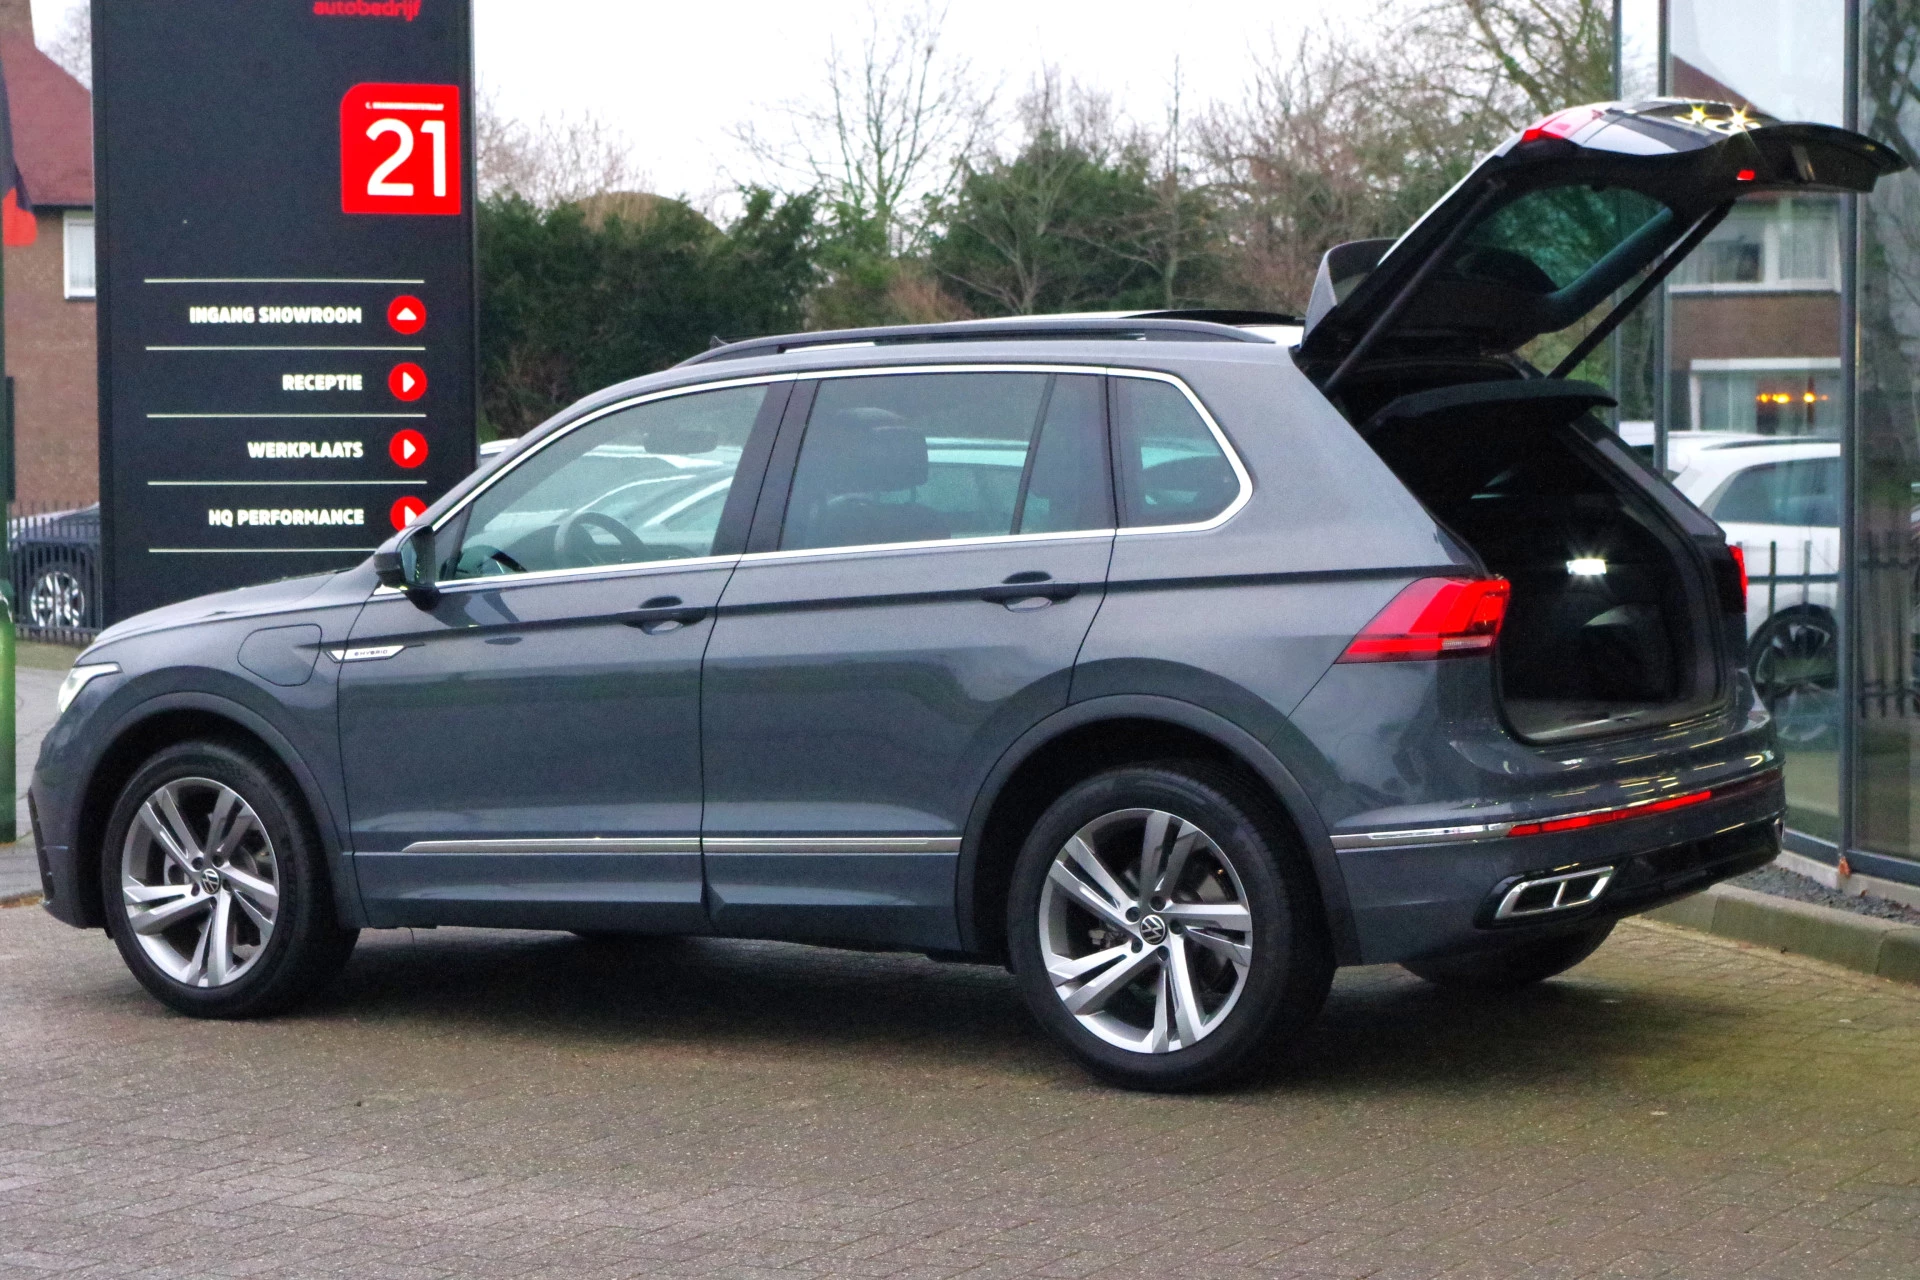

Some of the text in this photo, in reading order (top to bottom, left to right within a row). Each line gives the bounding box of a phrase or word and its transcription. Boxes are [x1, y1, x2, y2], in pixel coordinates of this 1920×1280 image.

[313, 0, 422, 21] autobedrijf
[366, 118, 446, 197] 21
[189, 306, 362, 324] INGANG SHOWROOM
[282, 374, 363, 391] RECEPTIE
[247, 441, 364, 458] WERKPLAATS
[208, 509, 365, 528] HQ PERFORMANCE
